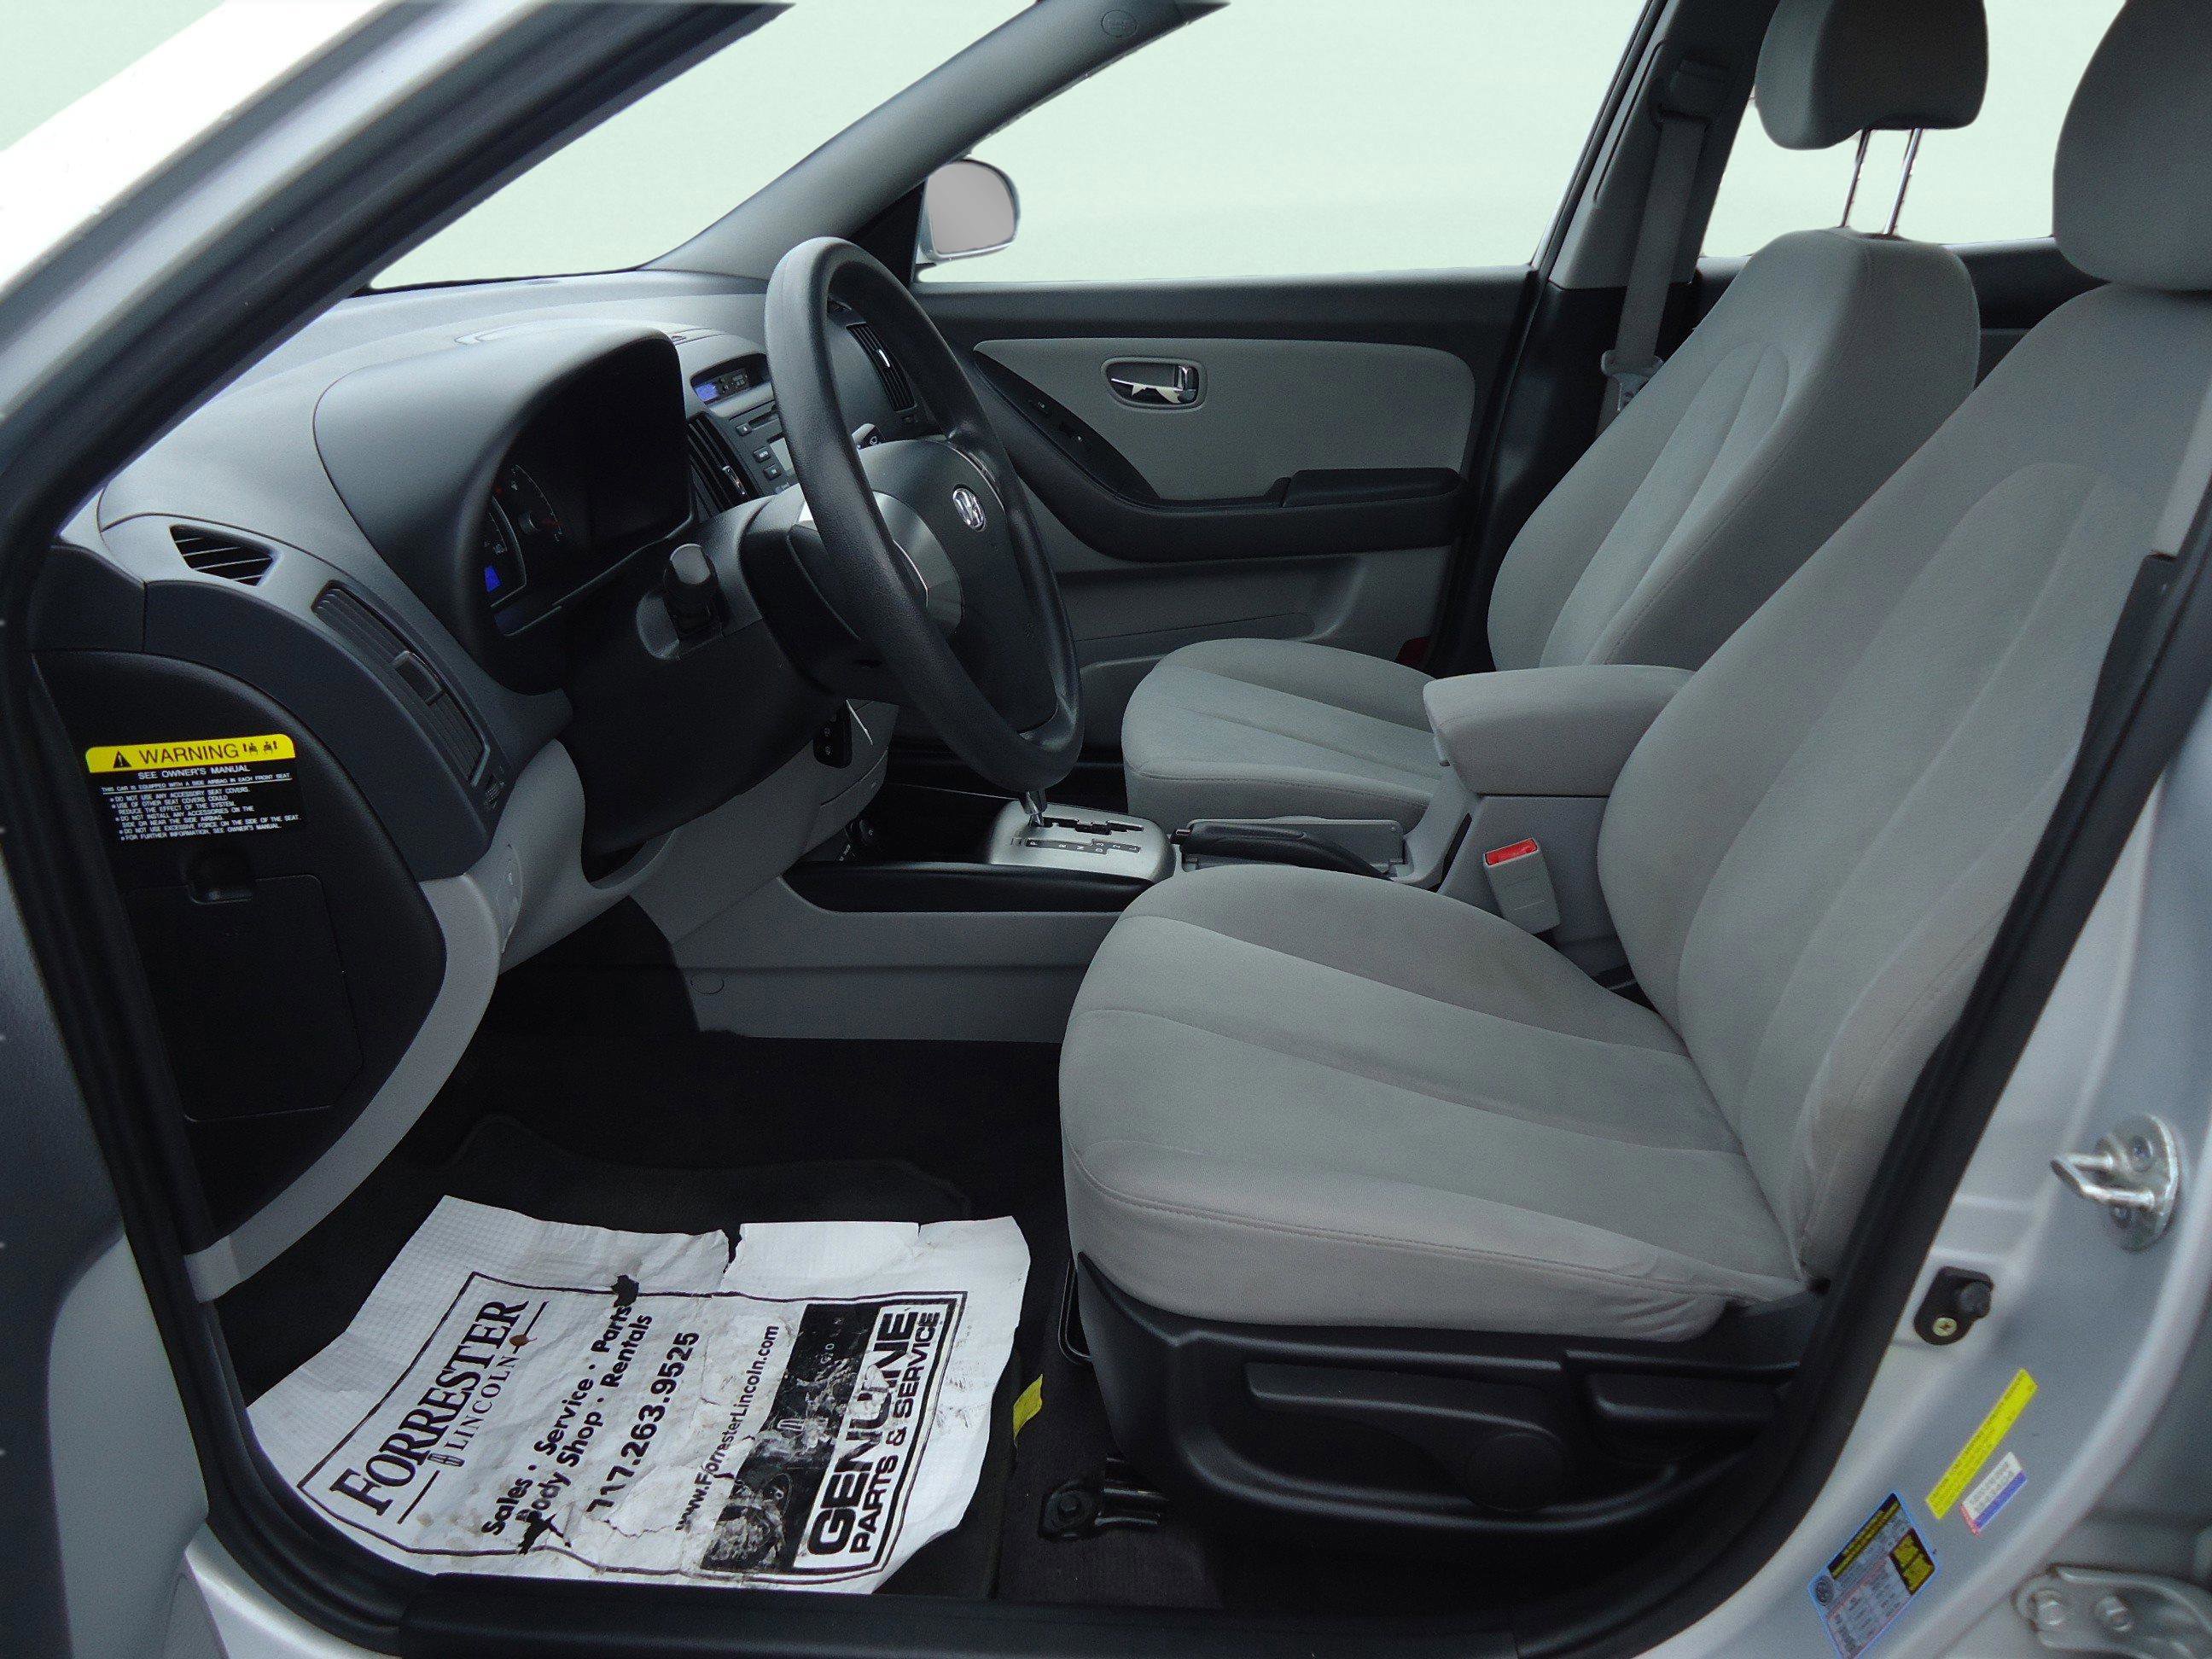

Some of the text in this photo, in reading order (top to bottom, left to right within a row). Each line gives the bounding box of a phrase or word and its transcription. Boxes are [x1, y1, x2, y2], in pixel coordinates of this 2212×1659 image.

[137, 765, 251, 780] SEE OWNER'S MANUAL
[138, 743, 239, 765] WARNING
[188, 807, 229, 817] ACCESSORIES
[329, 1300, 529, 1516] FORRESTER
[443, 1355, 521, 1451] LINCOLN
[480, 1305, 632, 1536] Sales Service Parts
[556, 1411, 604, 1468] Shop
[600, 1313, 653, 1388] Rentals
[848, 1311, 940, 1554] PARTS & SERVICE
